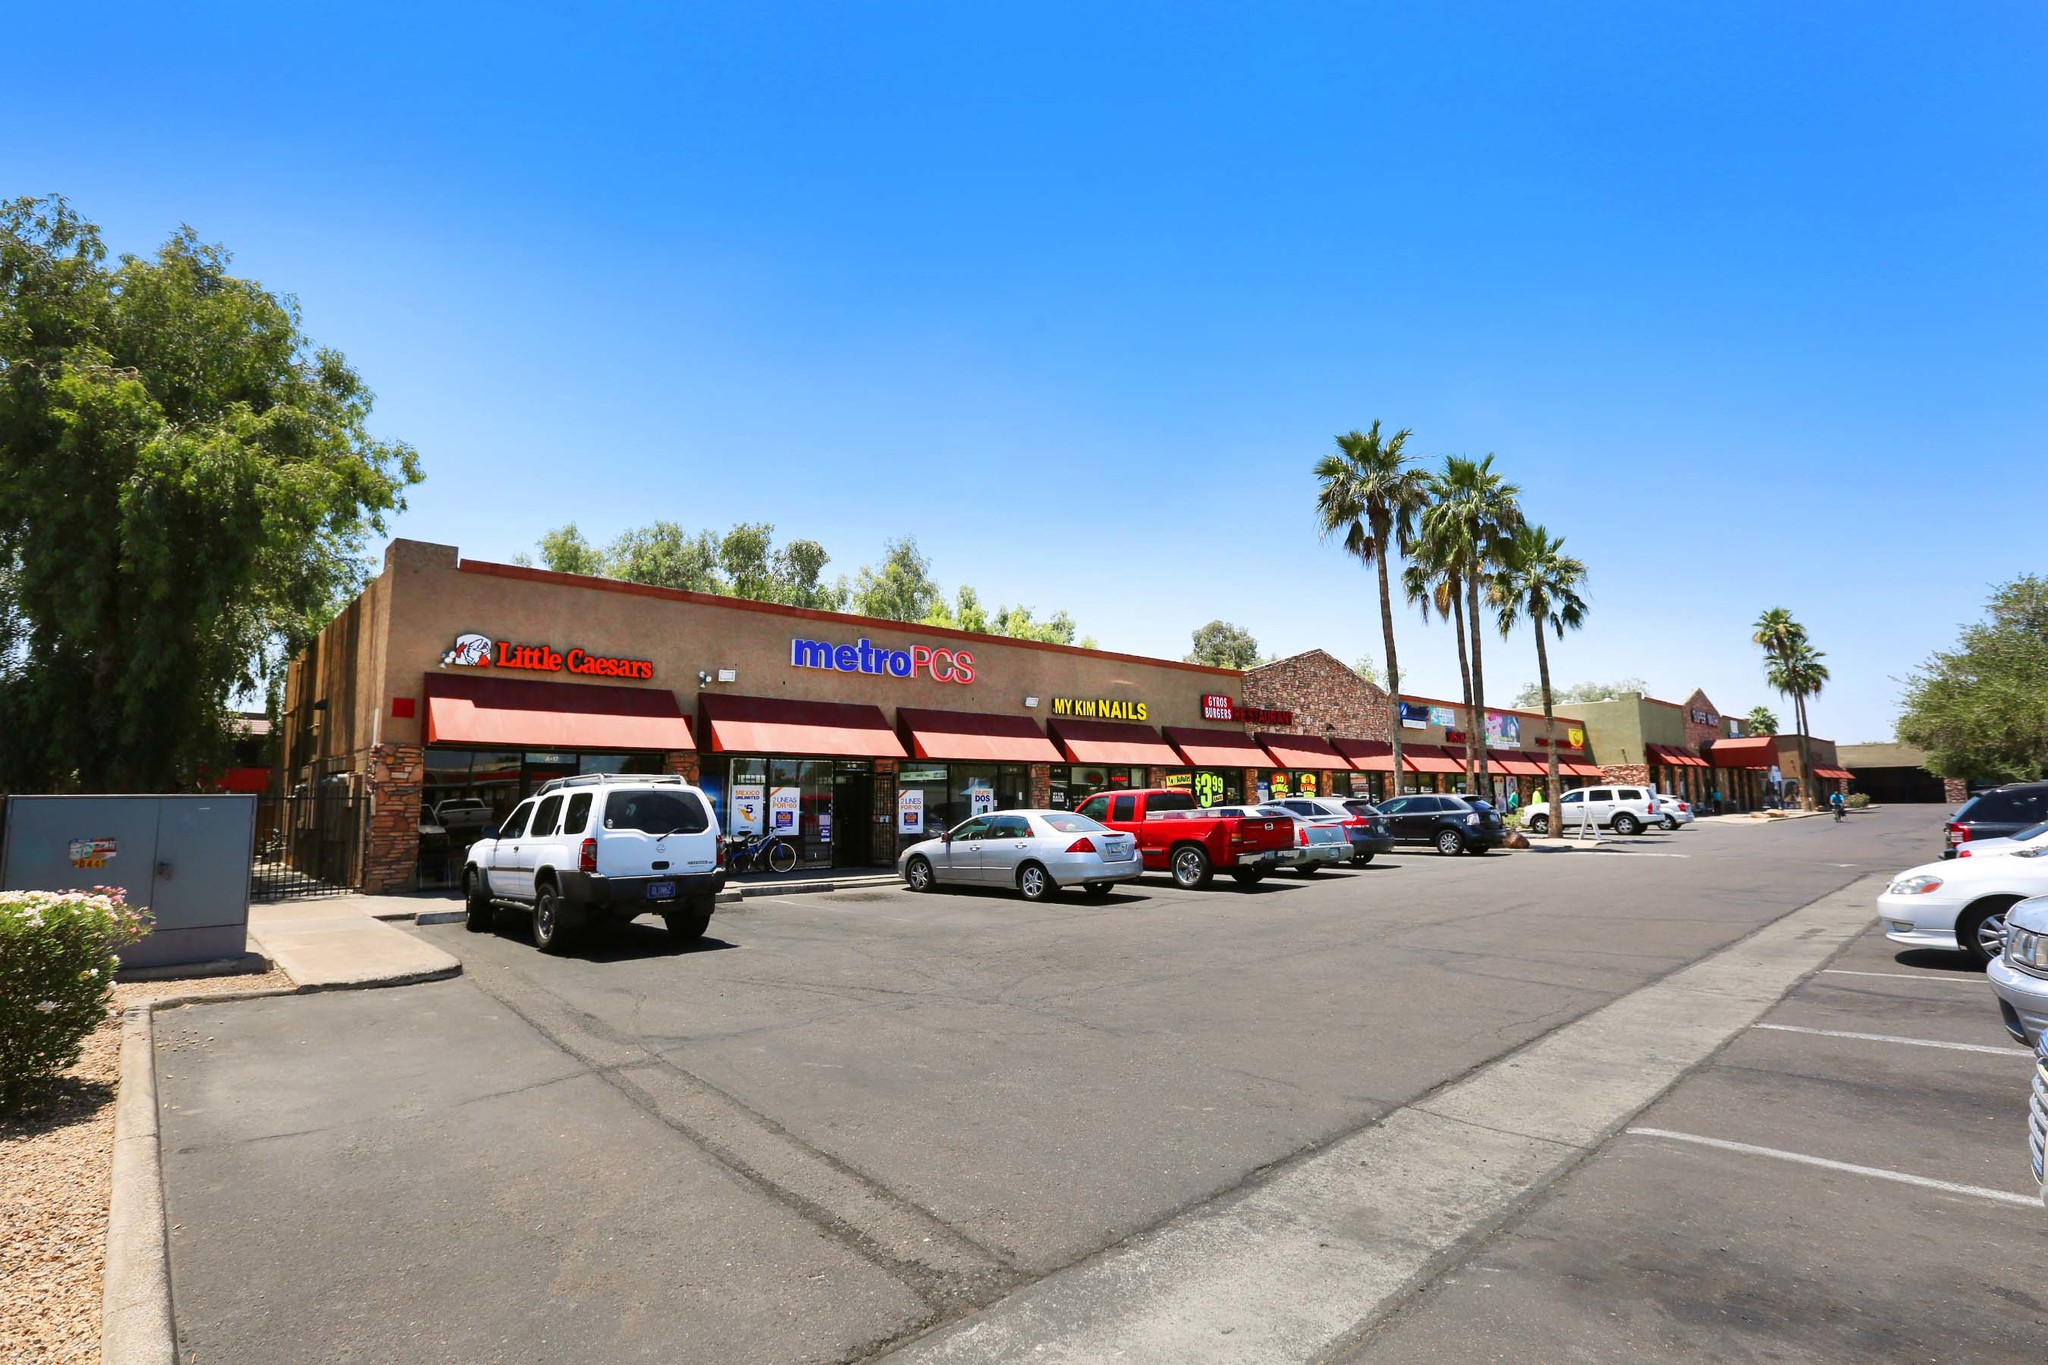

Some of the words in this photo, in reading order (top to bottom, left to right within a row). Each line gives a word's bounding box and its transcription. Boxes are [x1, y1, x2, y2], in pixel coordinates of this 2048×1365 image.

[496, 641, 563, 672] Little
[566, 648, 653, 679] Caesars
[791, 638, 976, 684] metroPCS
[1208, 695, 1228, 708] GYROS
[1054, 698, 1072, 715] MY
[1075, 699, 1096, 717] KIM
[1098, 699, 1147, 720] NAILS
[1204, 707, 1232, 720] BURGERS
[1275, 775, 1284, 783] 20
[975, 795, 991, 803] DOS
